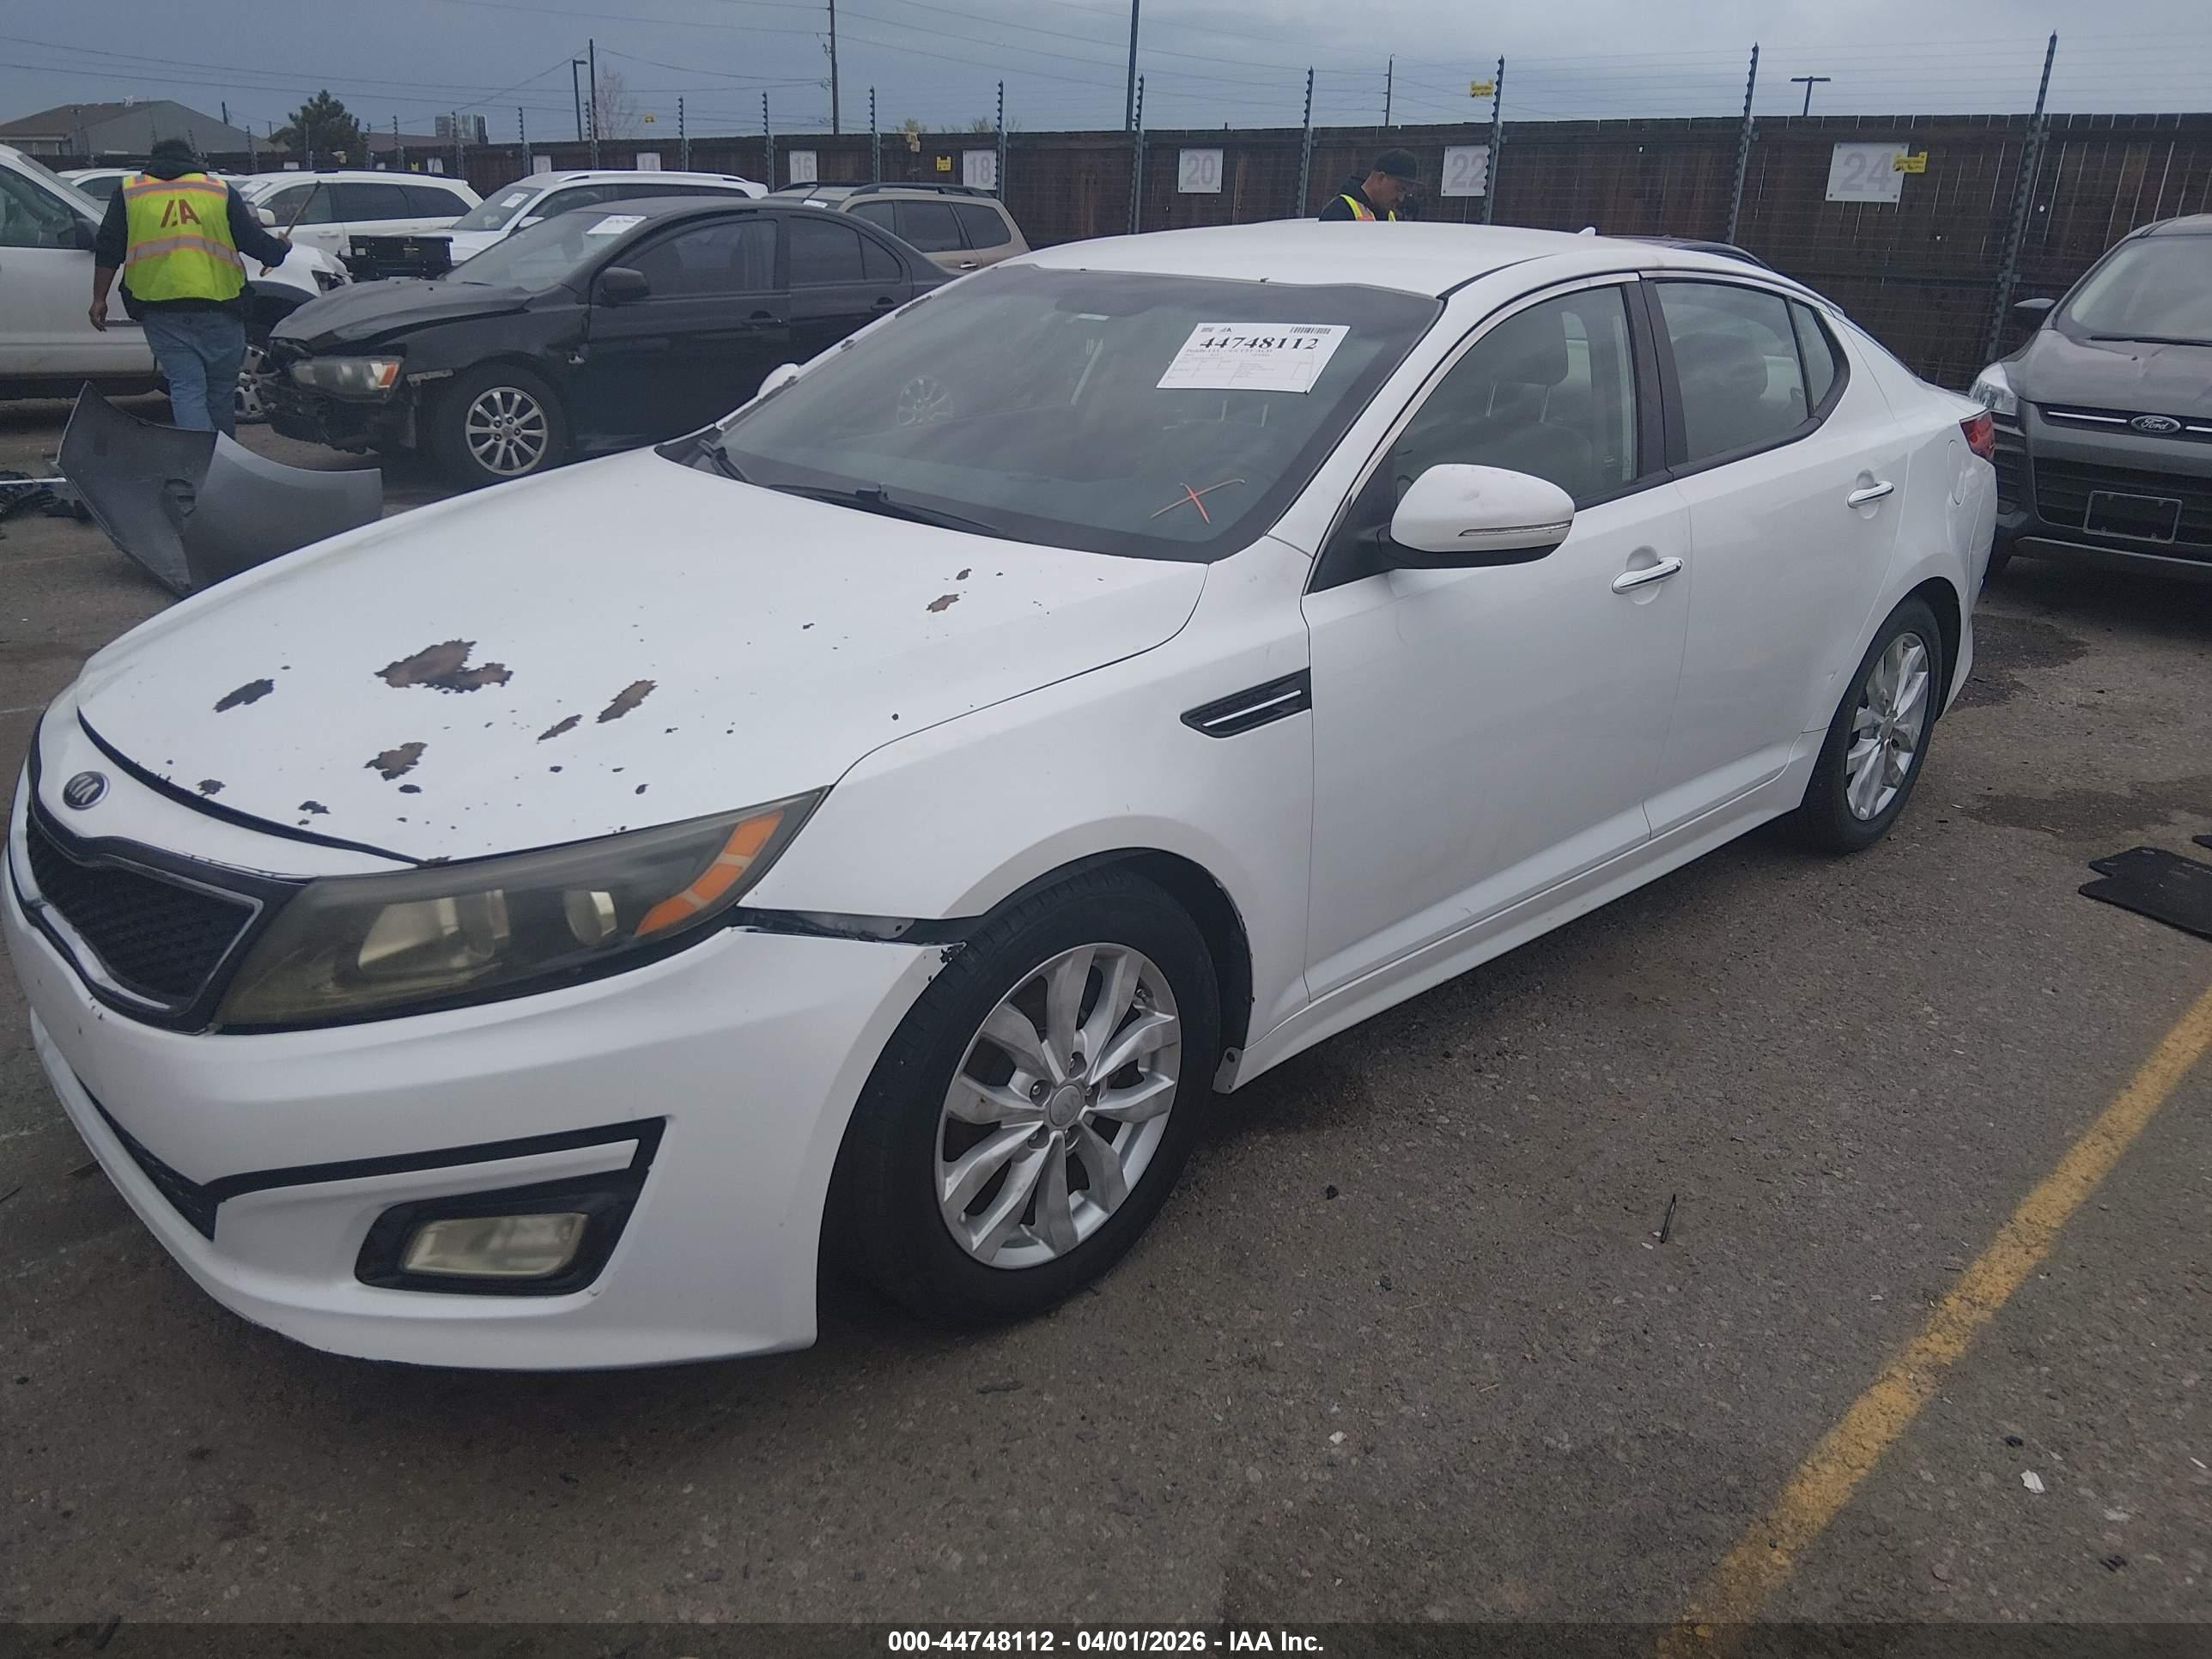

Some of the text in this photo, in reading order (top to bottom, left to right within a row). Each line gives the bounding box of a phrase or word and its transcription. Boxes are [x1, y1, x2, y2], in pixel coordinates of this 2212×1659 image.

[794, 155, 813, 180] 16
[969, 155, 992, 184] 18
[1185, 154, 1216, 185] 20
[1449, 153, 1488, 188] 22
[1838, 150, 1892, 192] 24
[1199, 336, 1320, 350] 44748112
[2142, 416, 2170, 431] Ford
